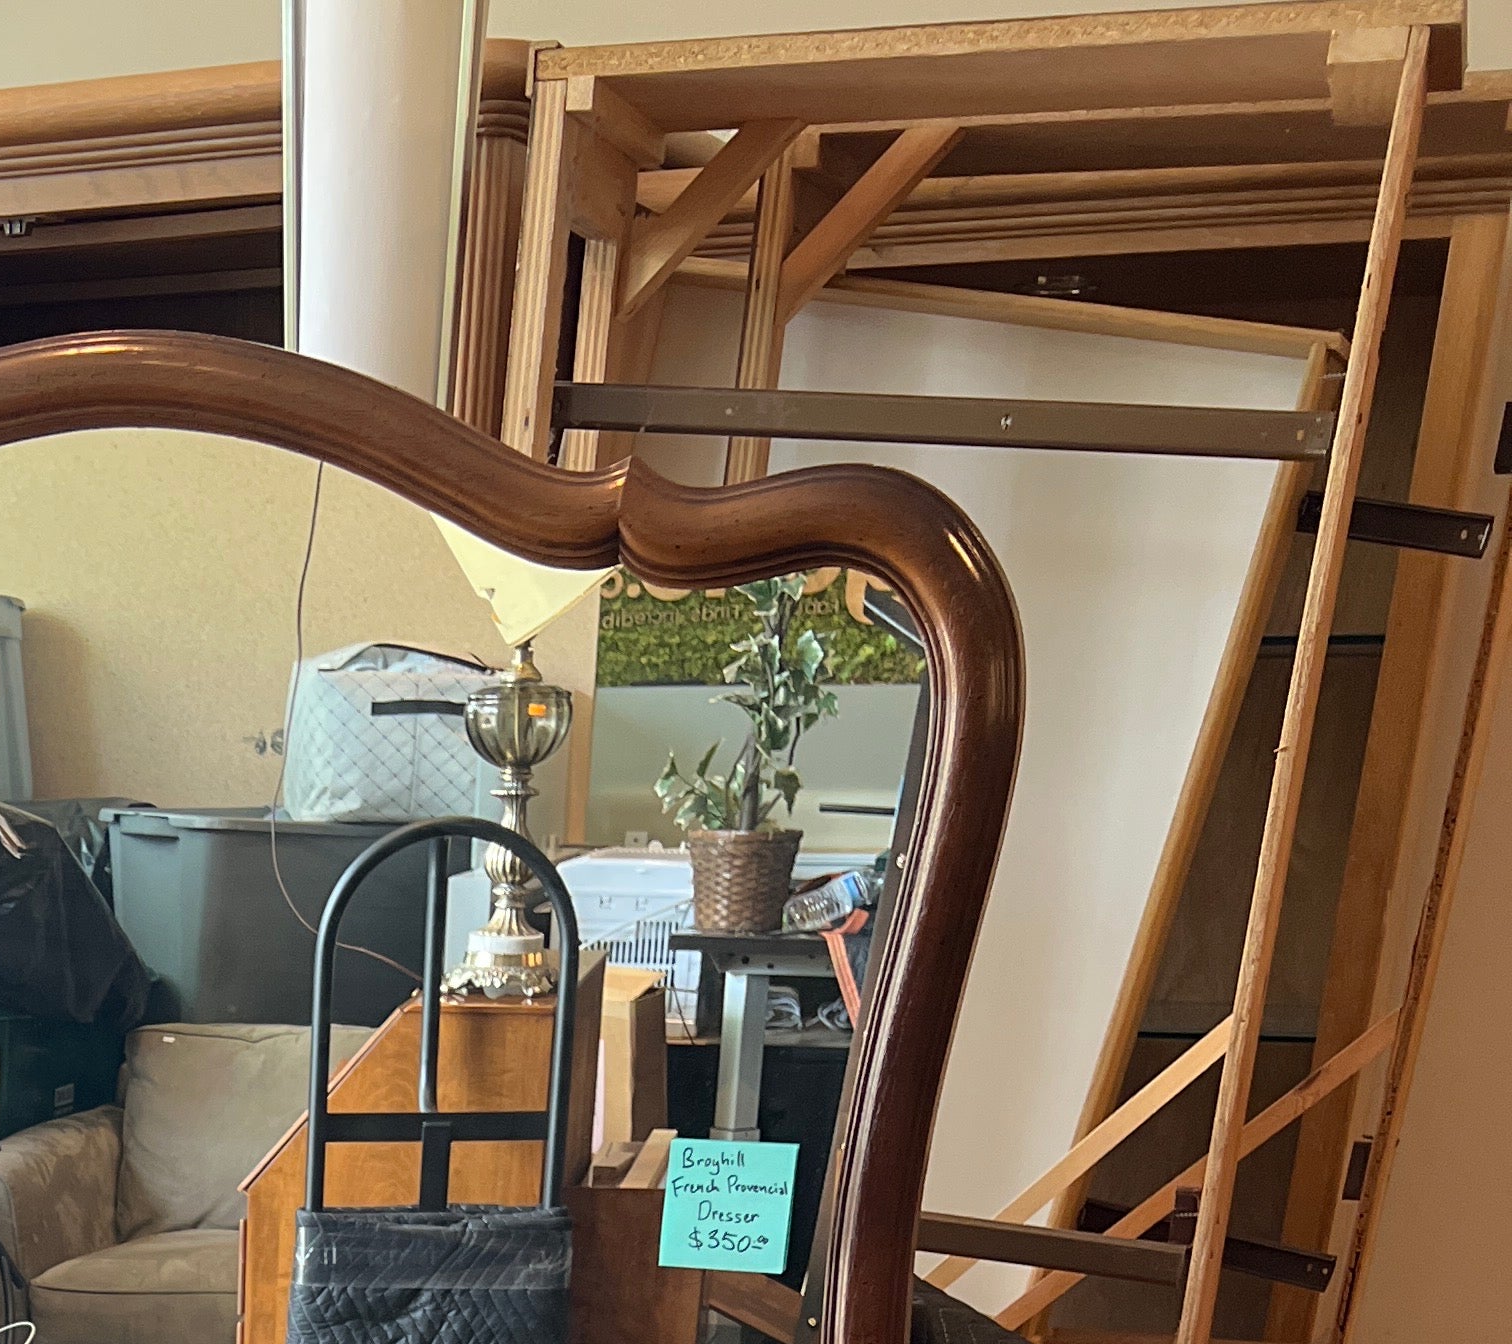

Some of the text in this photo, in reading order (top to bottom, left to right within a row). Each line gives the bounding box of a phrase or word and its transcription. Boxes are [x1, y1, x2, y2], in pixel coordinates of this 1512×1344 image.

[682, 1147, 745, 1175] Broyhill
[672, 1176, 720, 1197] French
[698, 1200, 759, 1222] Dresser
